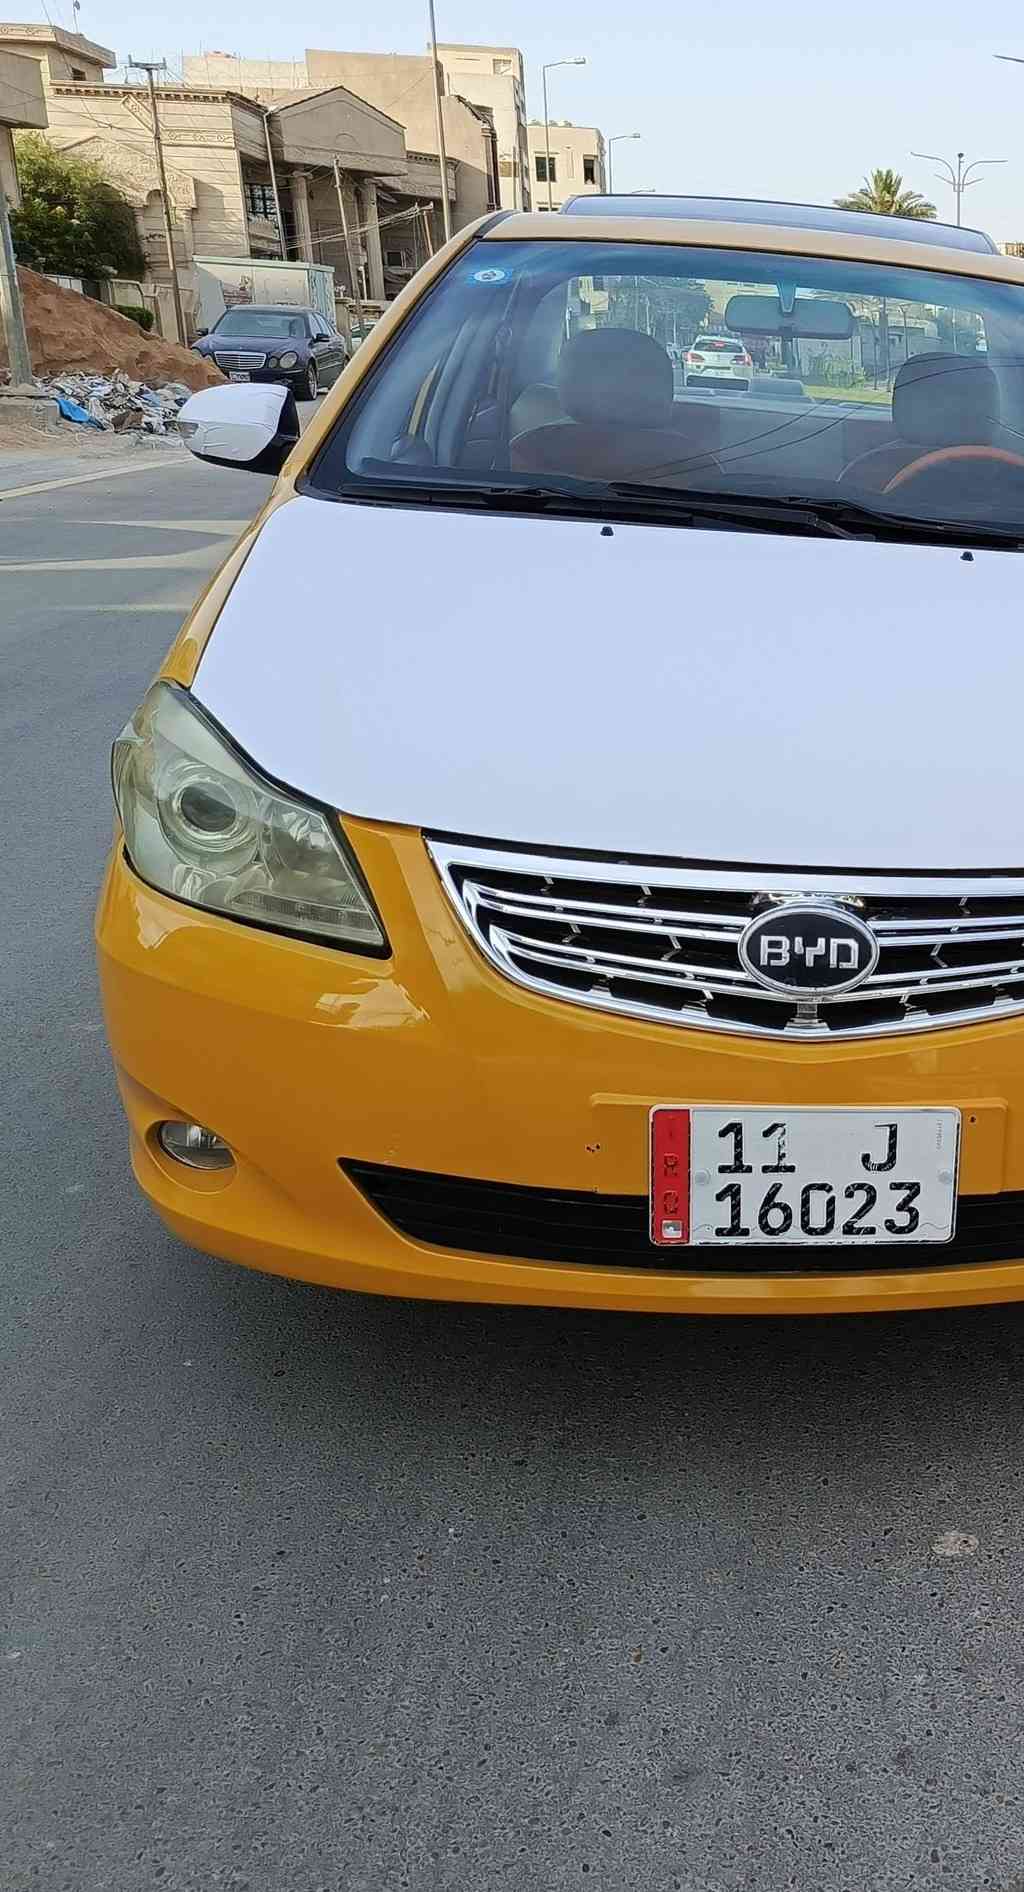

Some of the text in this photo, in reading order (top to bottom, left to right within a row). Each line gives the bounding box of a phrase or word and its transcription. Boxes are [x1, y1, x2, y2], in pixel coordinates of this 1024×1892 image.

[760, 935, 859, 969] BYD
[717, 1121, 796, 1174] 11
[861, 1123, 899, 1172] J
[714, 1182, 921, 1237] 16023
